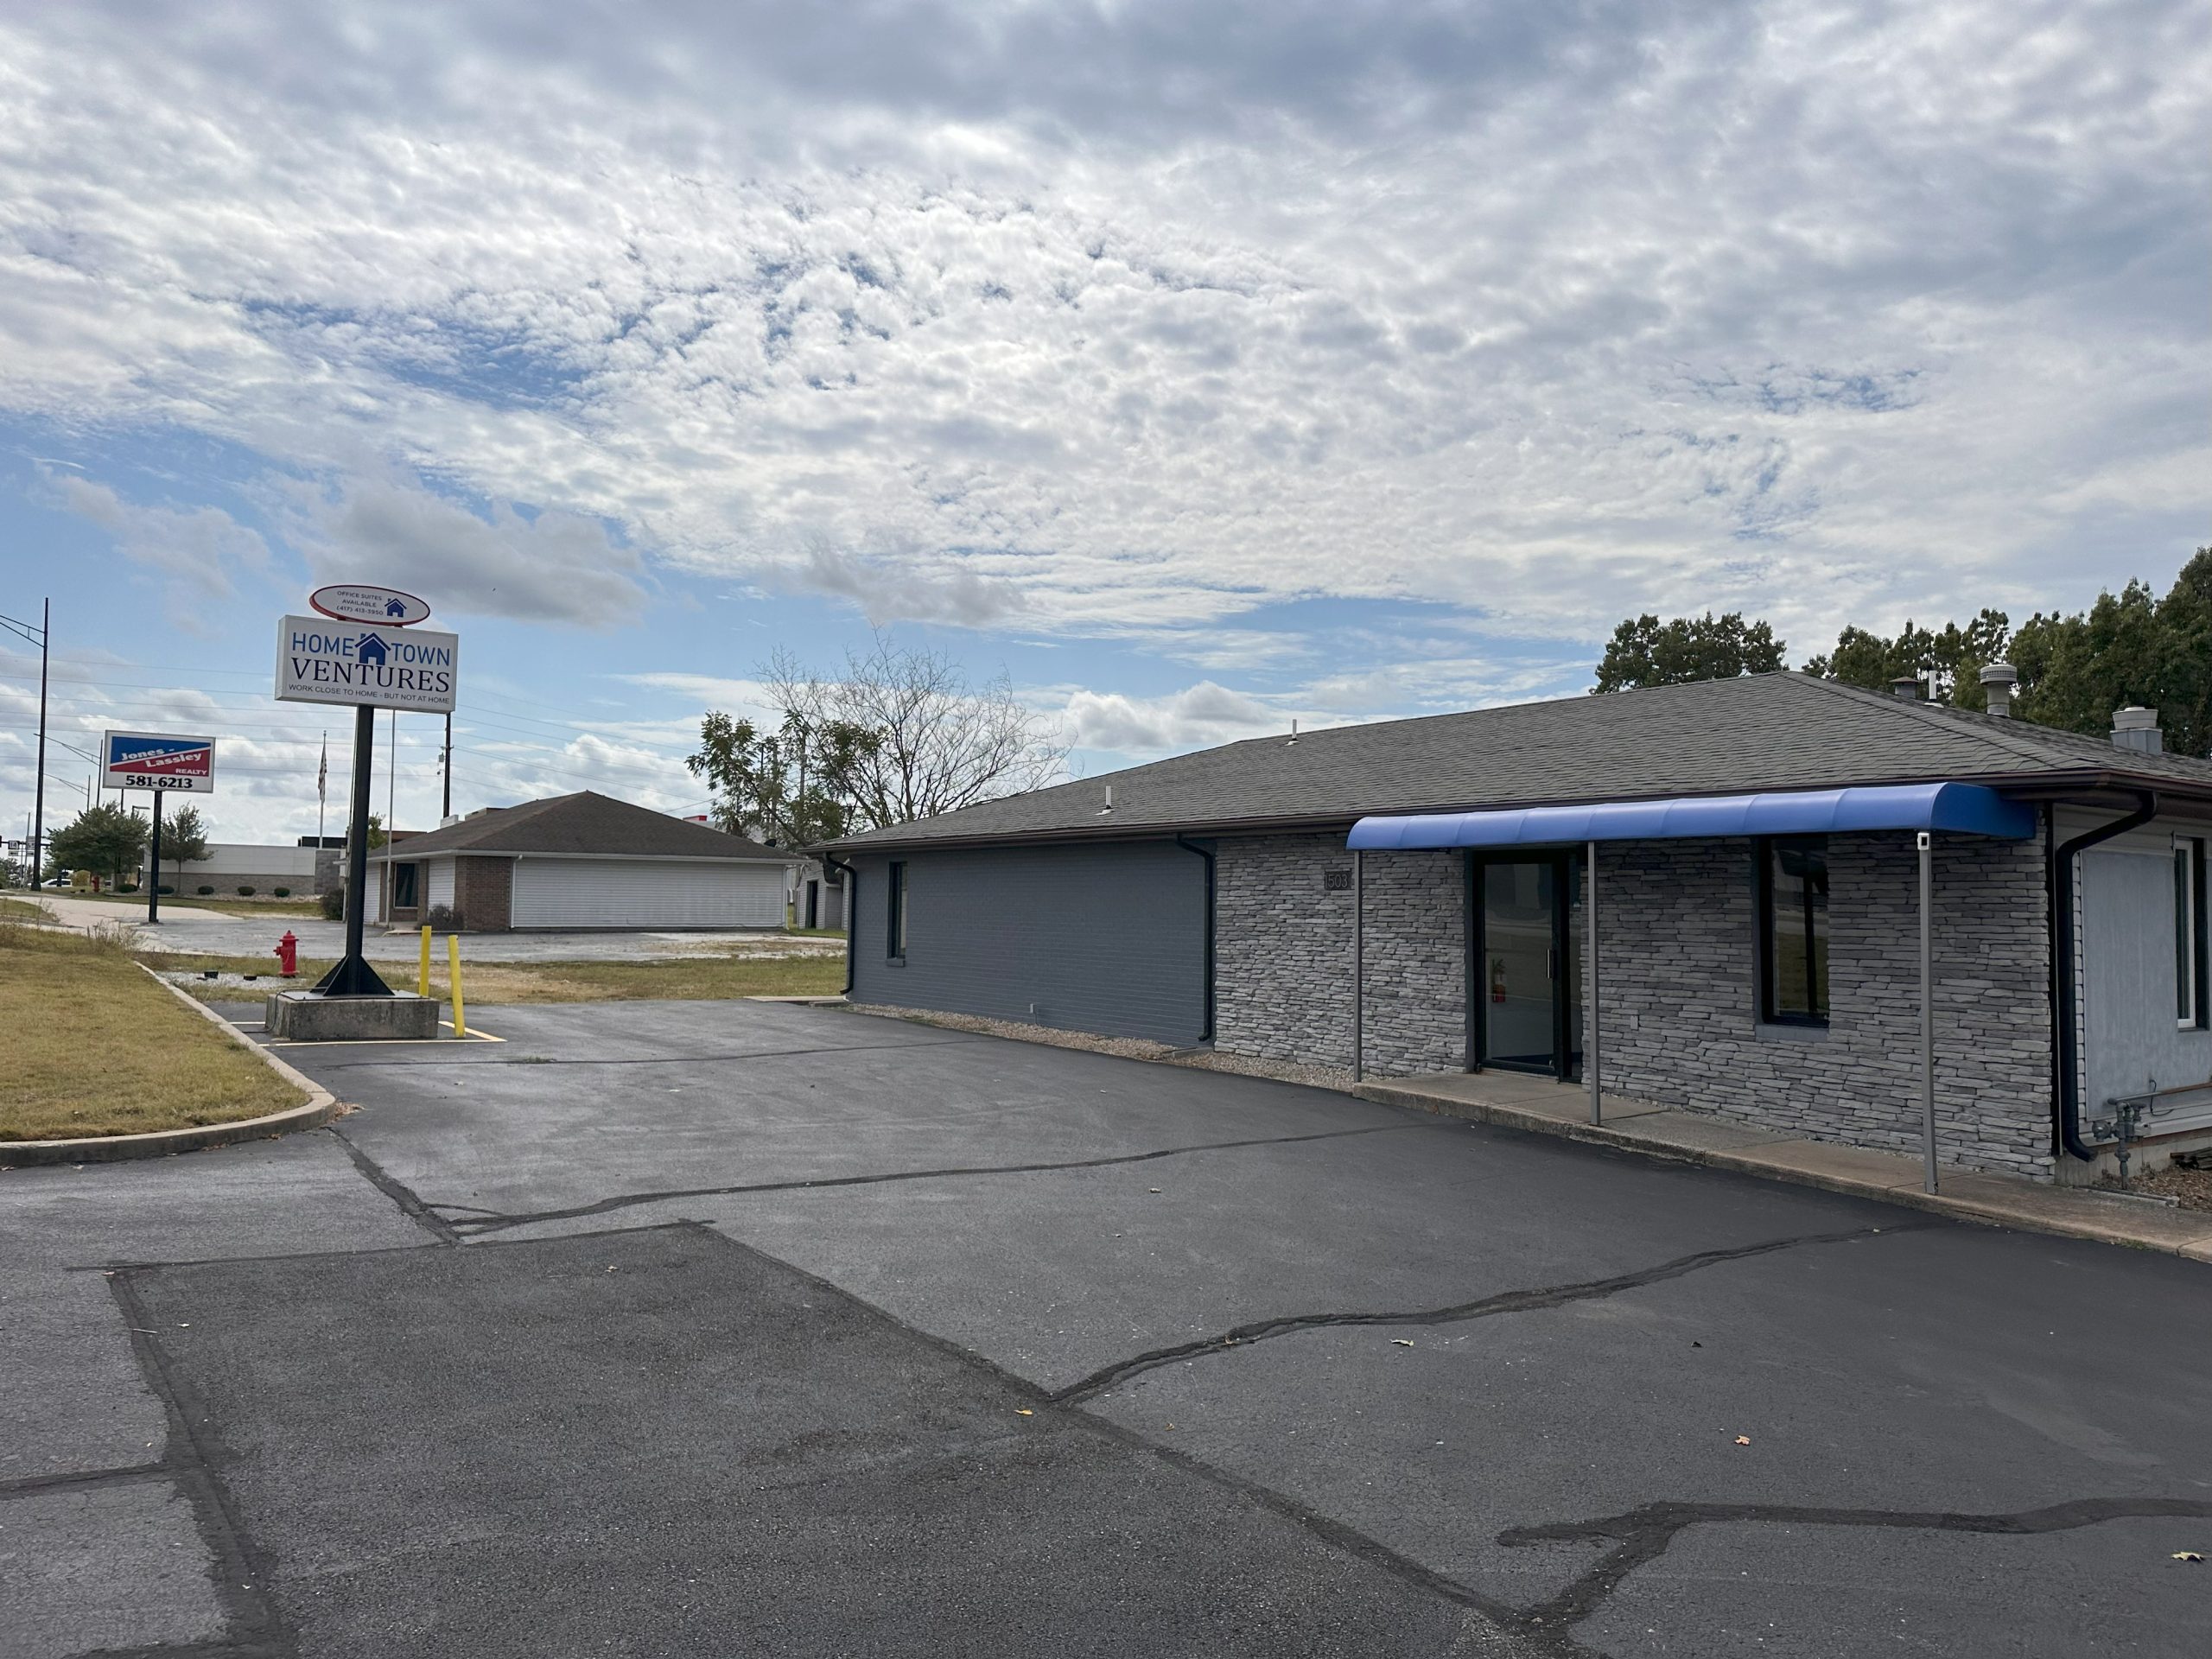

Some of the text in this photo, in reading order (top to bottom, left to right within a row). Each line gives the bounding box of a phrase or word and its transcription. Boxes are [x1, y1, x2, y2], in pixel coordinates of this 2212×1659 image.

[341, 599, 377, 607] AVAILABLE
[292, 632, 450, 666] HOME TOWN
[291, 657, 449, 693] VENTURES
[289, 683, 313, 692] WORK
[315, 686, 341, 695] CLOSE
[121, 748, 165, 761] Jones
[145, 753, 202, 768] Lassley
[125, 775, 193, 789] 581-6213
